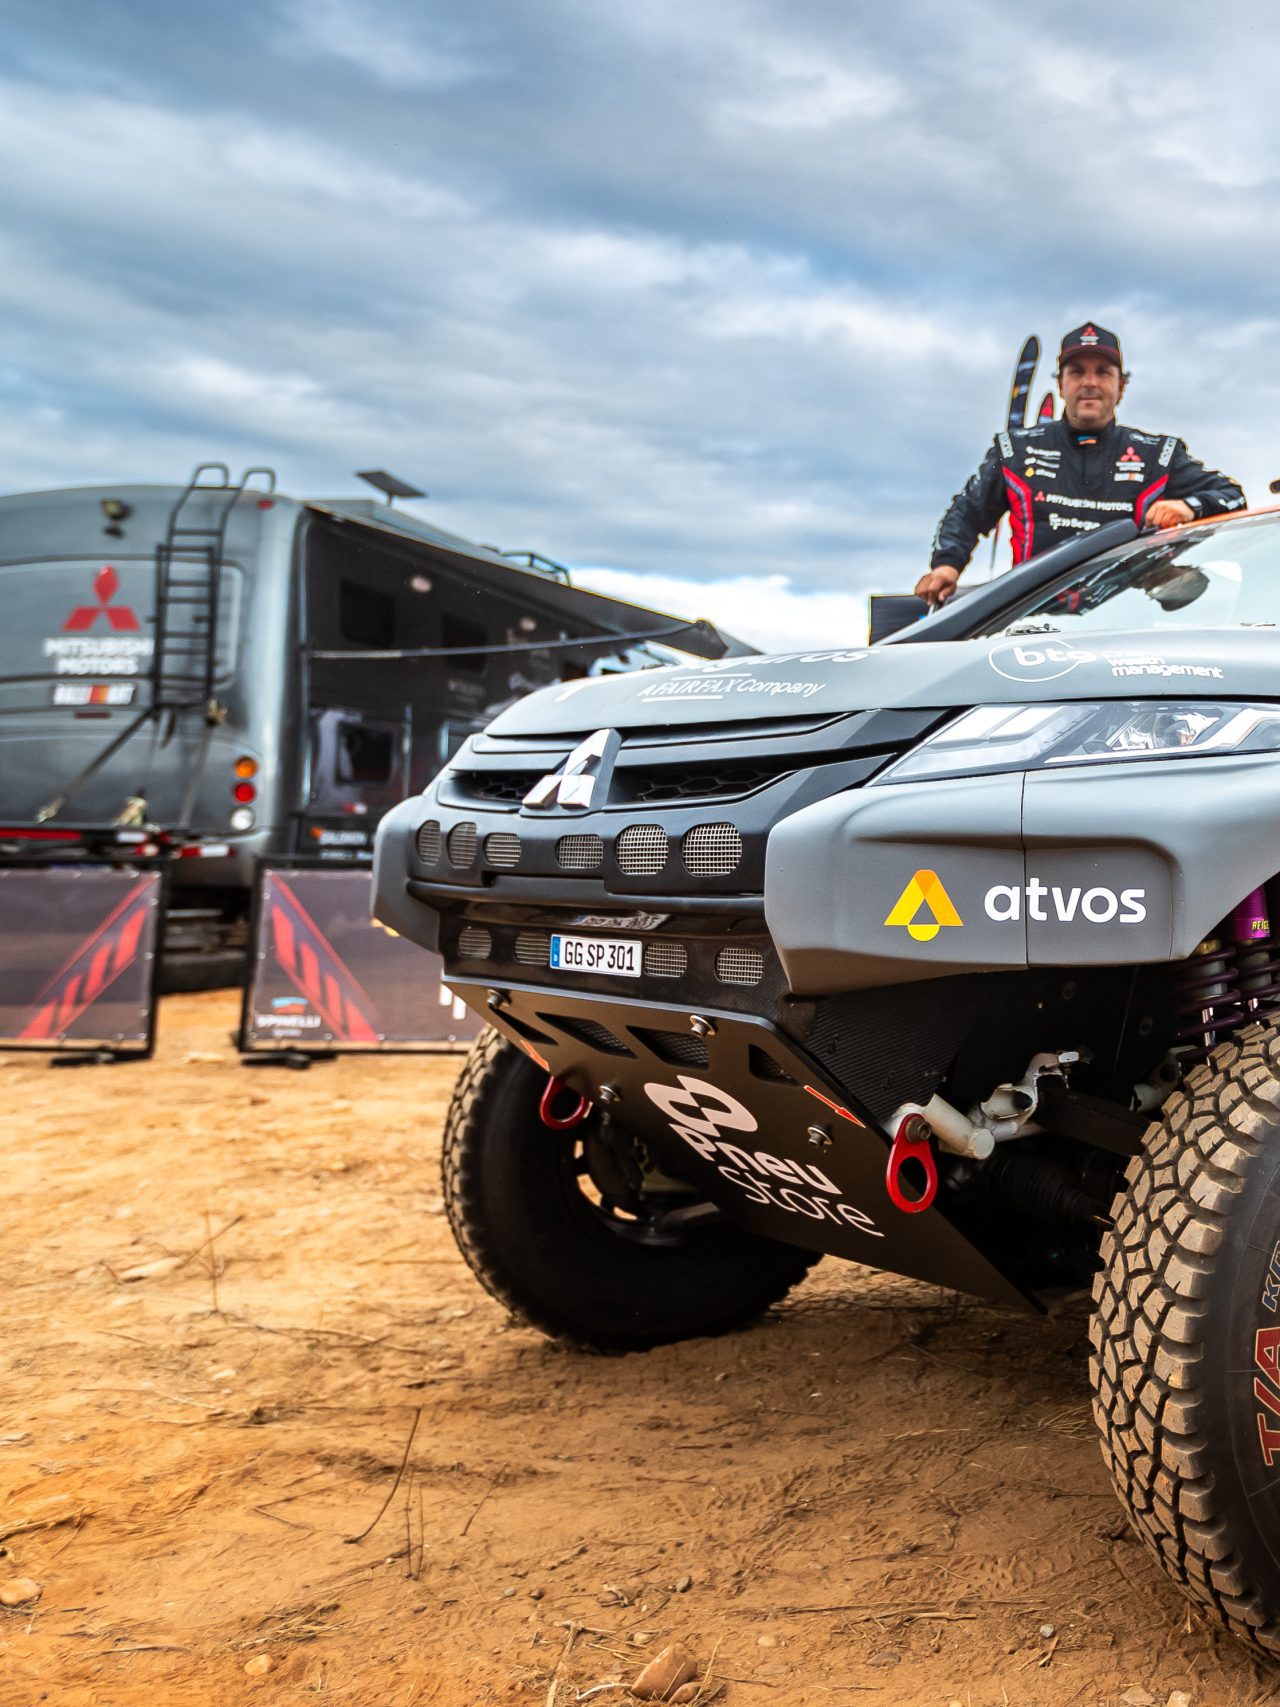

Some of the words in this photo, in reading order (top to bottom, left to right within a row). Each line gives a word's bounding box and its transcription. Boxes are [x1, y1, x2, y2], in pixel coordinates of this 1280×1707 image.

[1097, 501, 1133, 512] MOTORS
[1013, 647, 1098, 667] btg
[1112, 664, 1225, 678] management
[737, 679, 827, 698] Company
[984, 878, 1147, 924] atvos
[565, 941, 583, 966] GG
[587, 943, 604, 968] SP
[607, 945, 635, 971] 301
